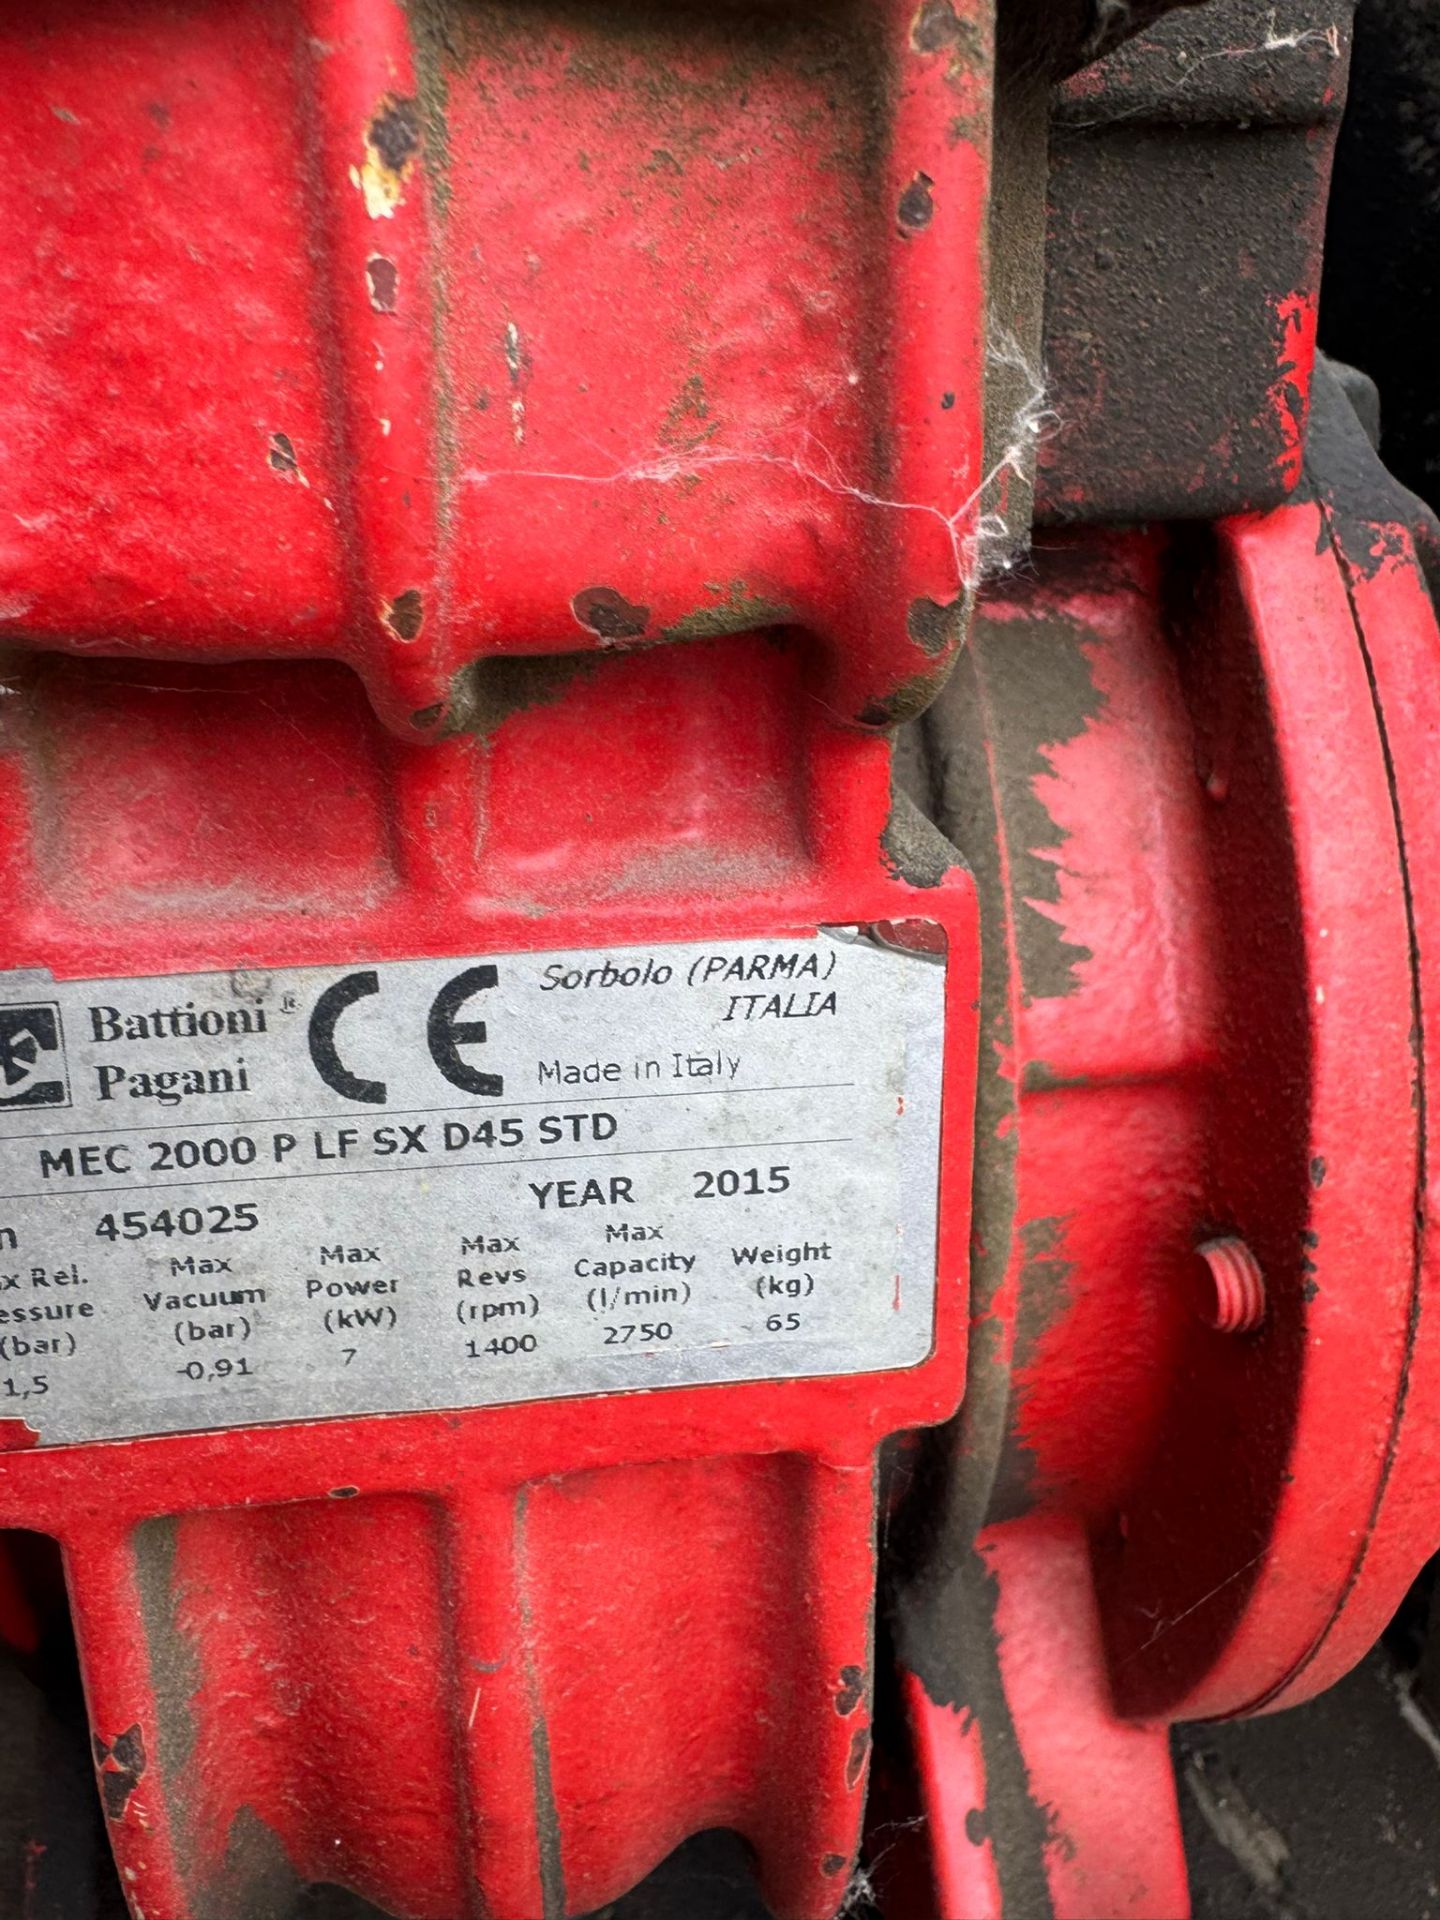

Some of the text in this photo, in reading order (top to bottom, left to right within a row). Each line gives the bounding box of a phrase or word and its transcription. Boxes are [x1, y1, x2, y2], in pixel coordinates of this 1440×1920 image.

[540, 950, 836, 991] Sorbolo (PARMA)
[723, 991, 836, 1021] ITALIA
[87, 998, 268, 1043] Battioni
[538, 1050, 741, 1085] Made in Italy
[93, 1057, 251, 1106] Pagani
[40, 1112, 618, 1178] MEC 2000 P LF SX D45 STD
[528, 1165, 791, 1210] YEAR 2015
[95, 1203, 259, 1241] 454025
[606, 1223, 664, 1243] Max
[319, 1245, 381, 1265] Max
[461, 1236, 520, 1255] Max
[731, 1241, 832, 1267] Weight
[0, 1264, 89, 1291] x Rel.
[170, 1257, 233, 1276] Max
[458, 1266, 527, 1288] Revs
[574, 1252, 697, 1279] Capacity
[306, 1277, 399, 1299] Power
[587, 1281, 692, 1312] (l/min)
[756, 1272, 816, 1299] (kg)
[144, 1288, 267, 1312] Vacuum
[457, 1295, 540, 1325] (rpm)
[175, 1317, 251, 1346] (bar)
[324, 1306, 397, 1335] (kW)
[603, 1321, 673, 1345] 2750
[766, 1313, 801, 1333] 65
[0, 1332, 77, 1361] (bar)
[340, 1348, 357, 1367] 7
[465, 1334, 538, 1359] 1400
[176, 1357, 254, 1381] -0,91
[2, 1375, 50, 1399] 1,5
